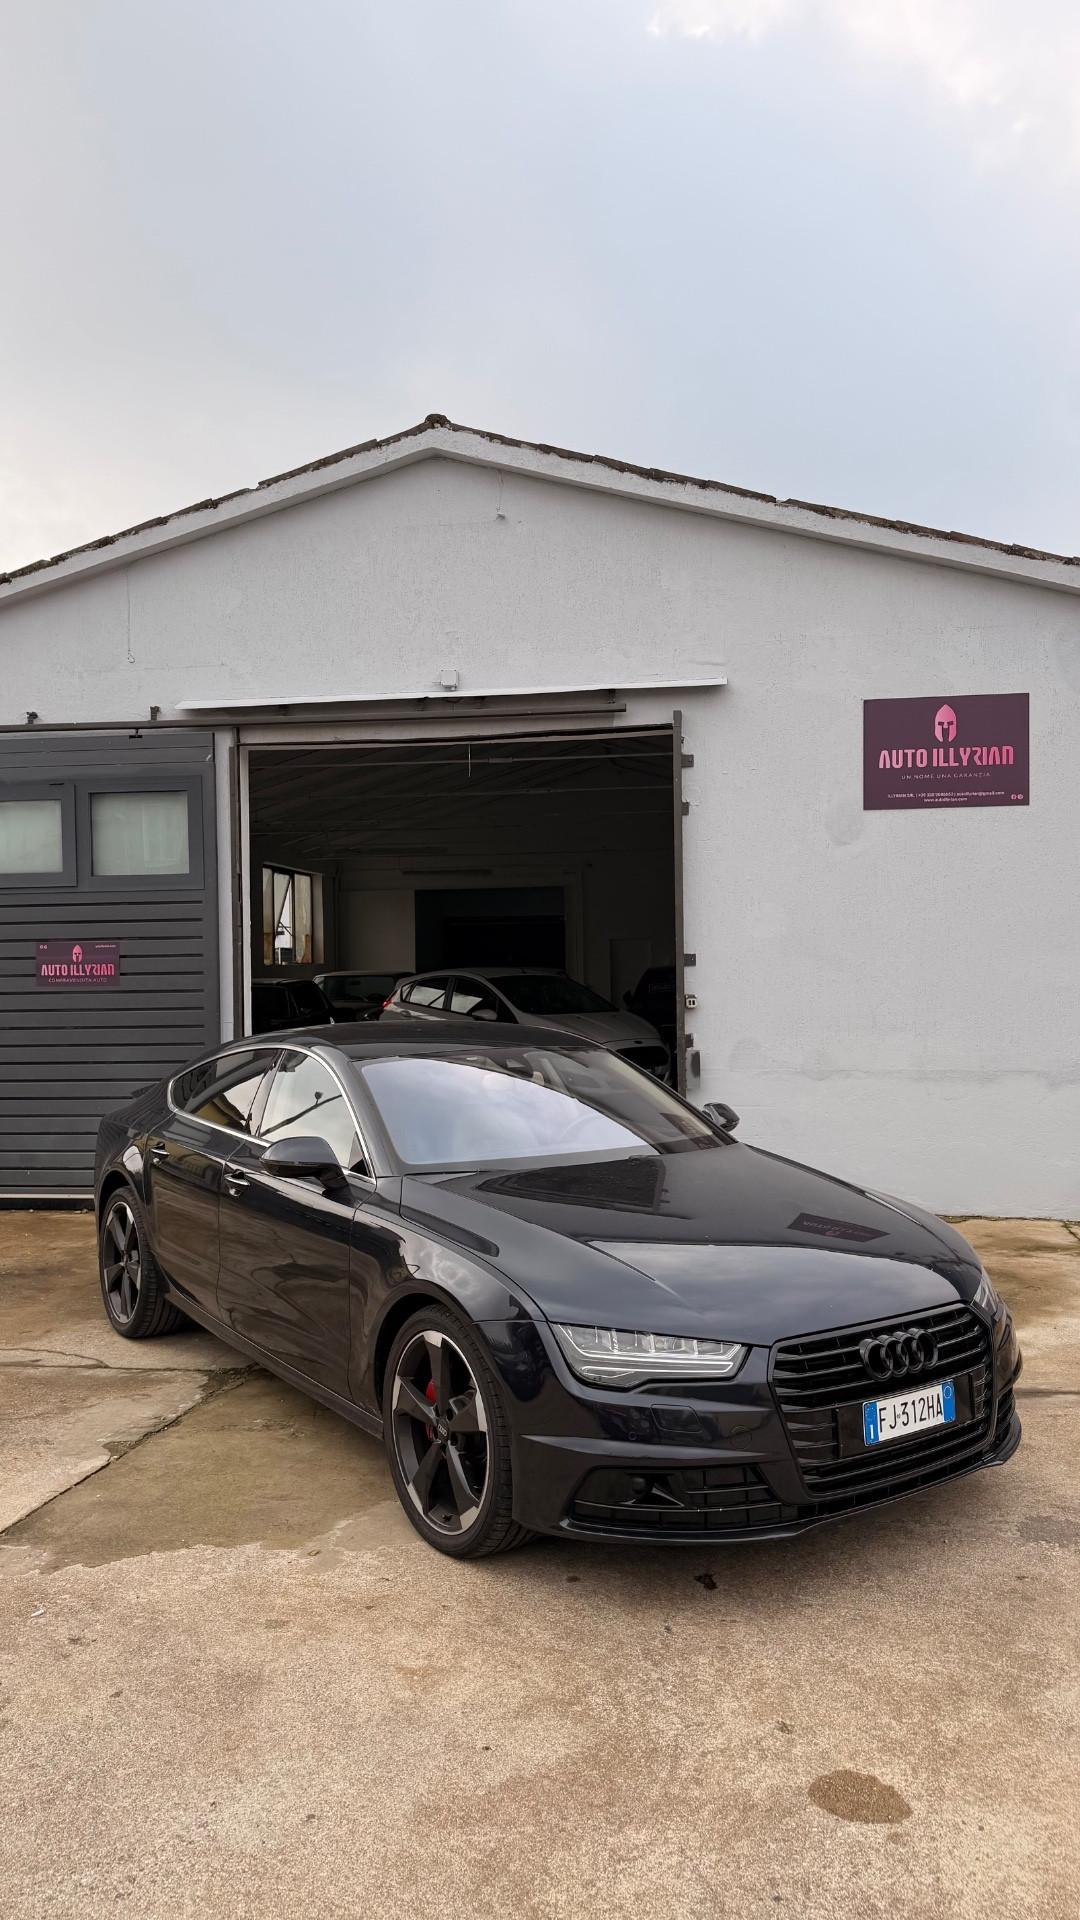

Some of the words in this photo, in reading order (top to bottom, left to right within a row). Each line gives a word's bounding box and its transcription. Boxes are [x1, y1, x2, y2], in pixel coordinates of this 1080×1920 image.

[879, 748, 928, 769] AUTO
[933, 746, 1014, 767] ILLYRIAN
[41, 964, 68, 976] AUTO
[70, 963, 115, 976] ILLYRIAN
